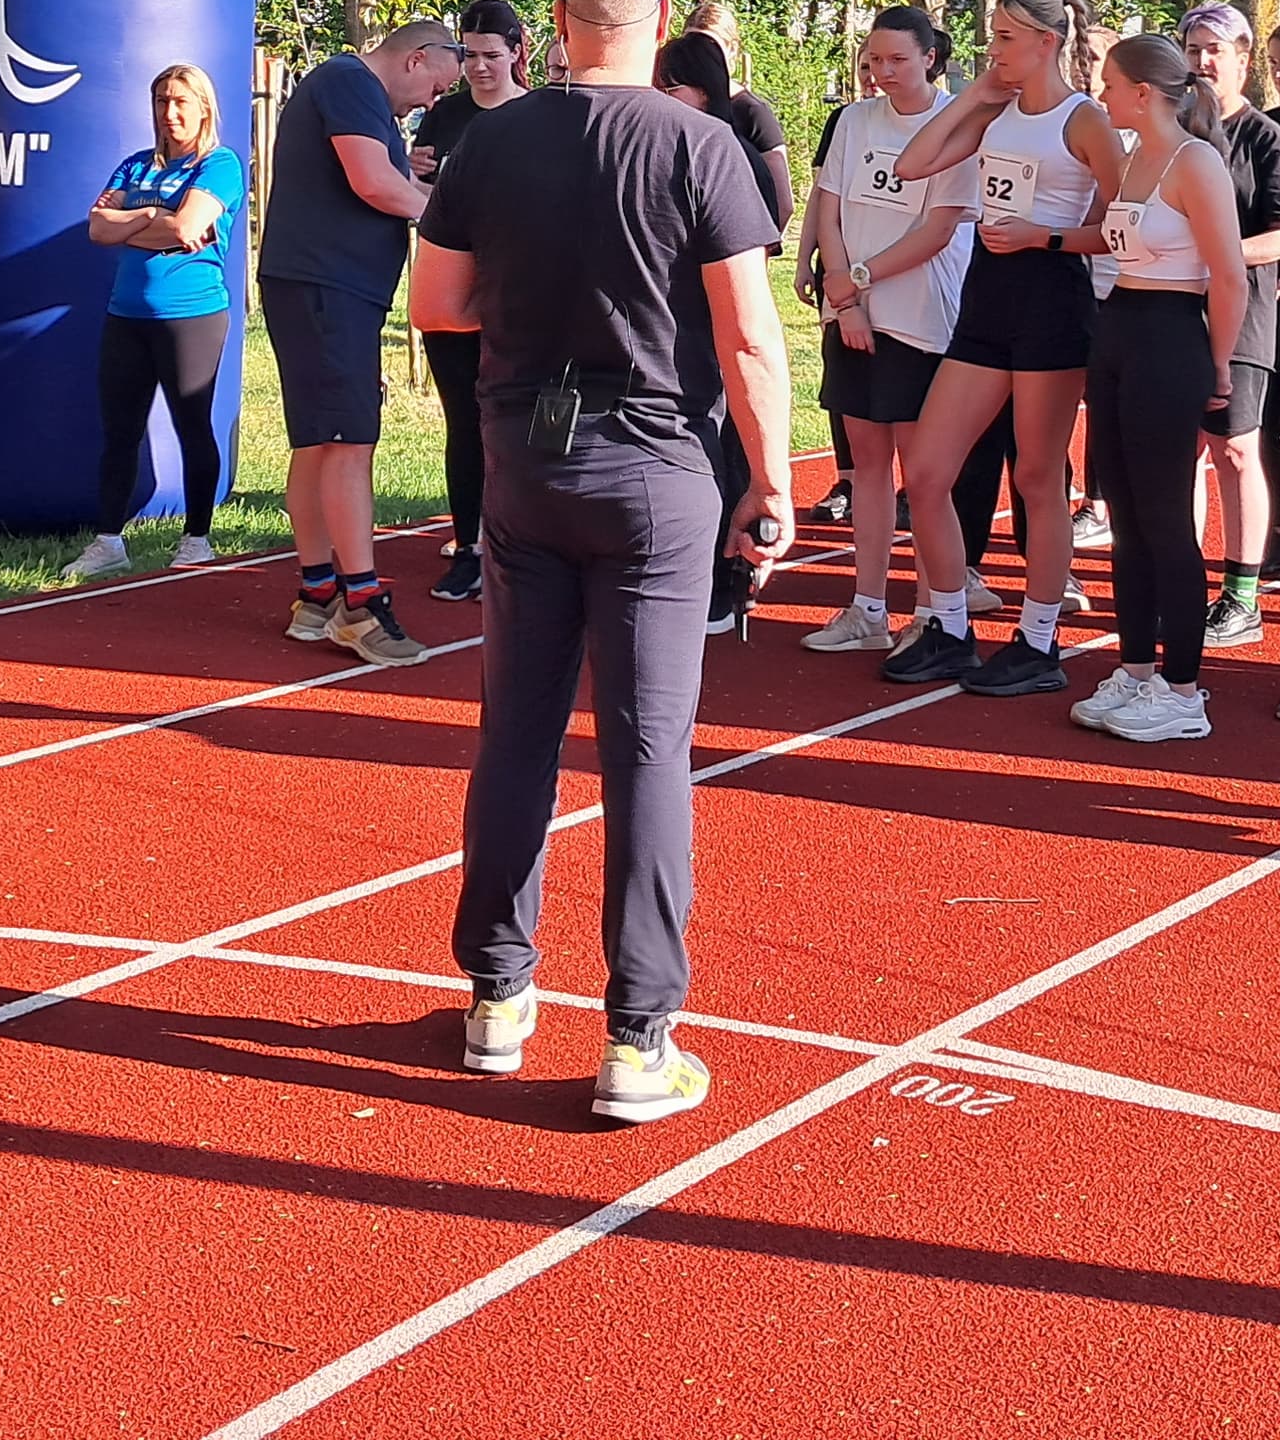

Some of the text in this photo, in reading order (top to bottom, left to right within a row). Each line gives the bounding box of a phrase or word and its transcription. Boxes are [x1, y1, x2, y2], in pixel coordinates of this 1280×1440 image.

[872, 170, 903, 194] 93
[985, 176, 1014, 201] 52
[1109, 229, 1127, 252] 51
[889, 1075, 1017, 1117] 200
